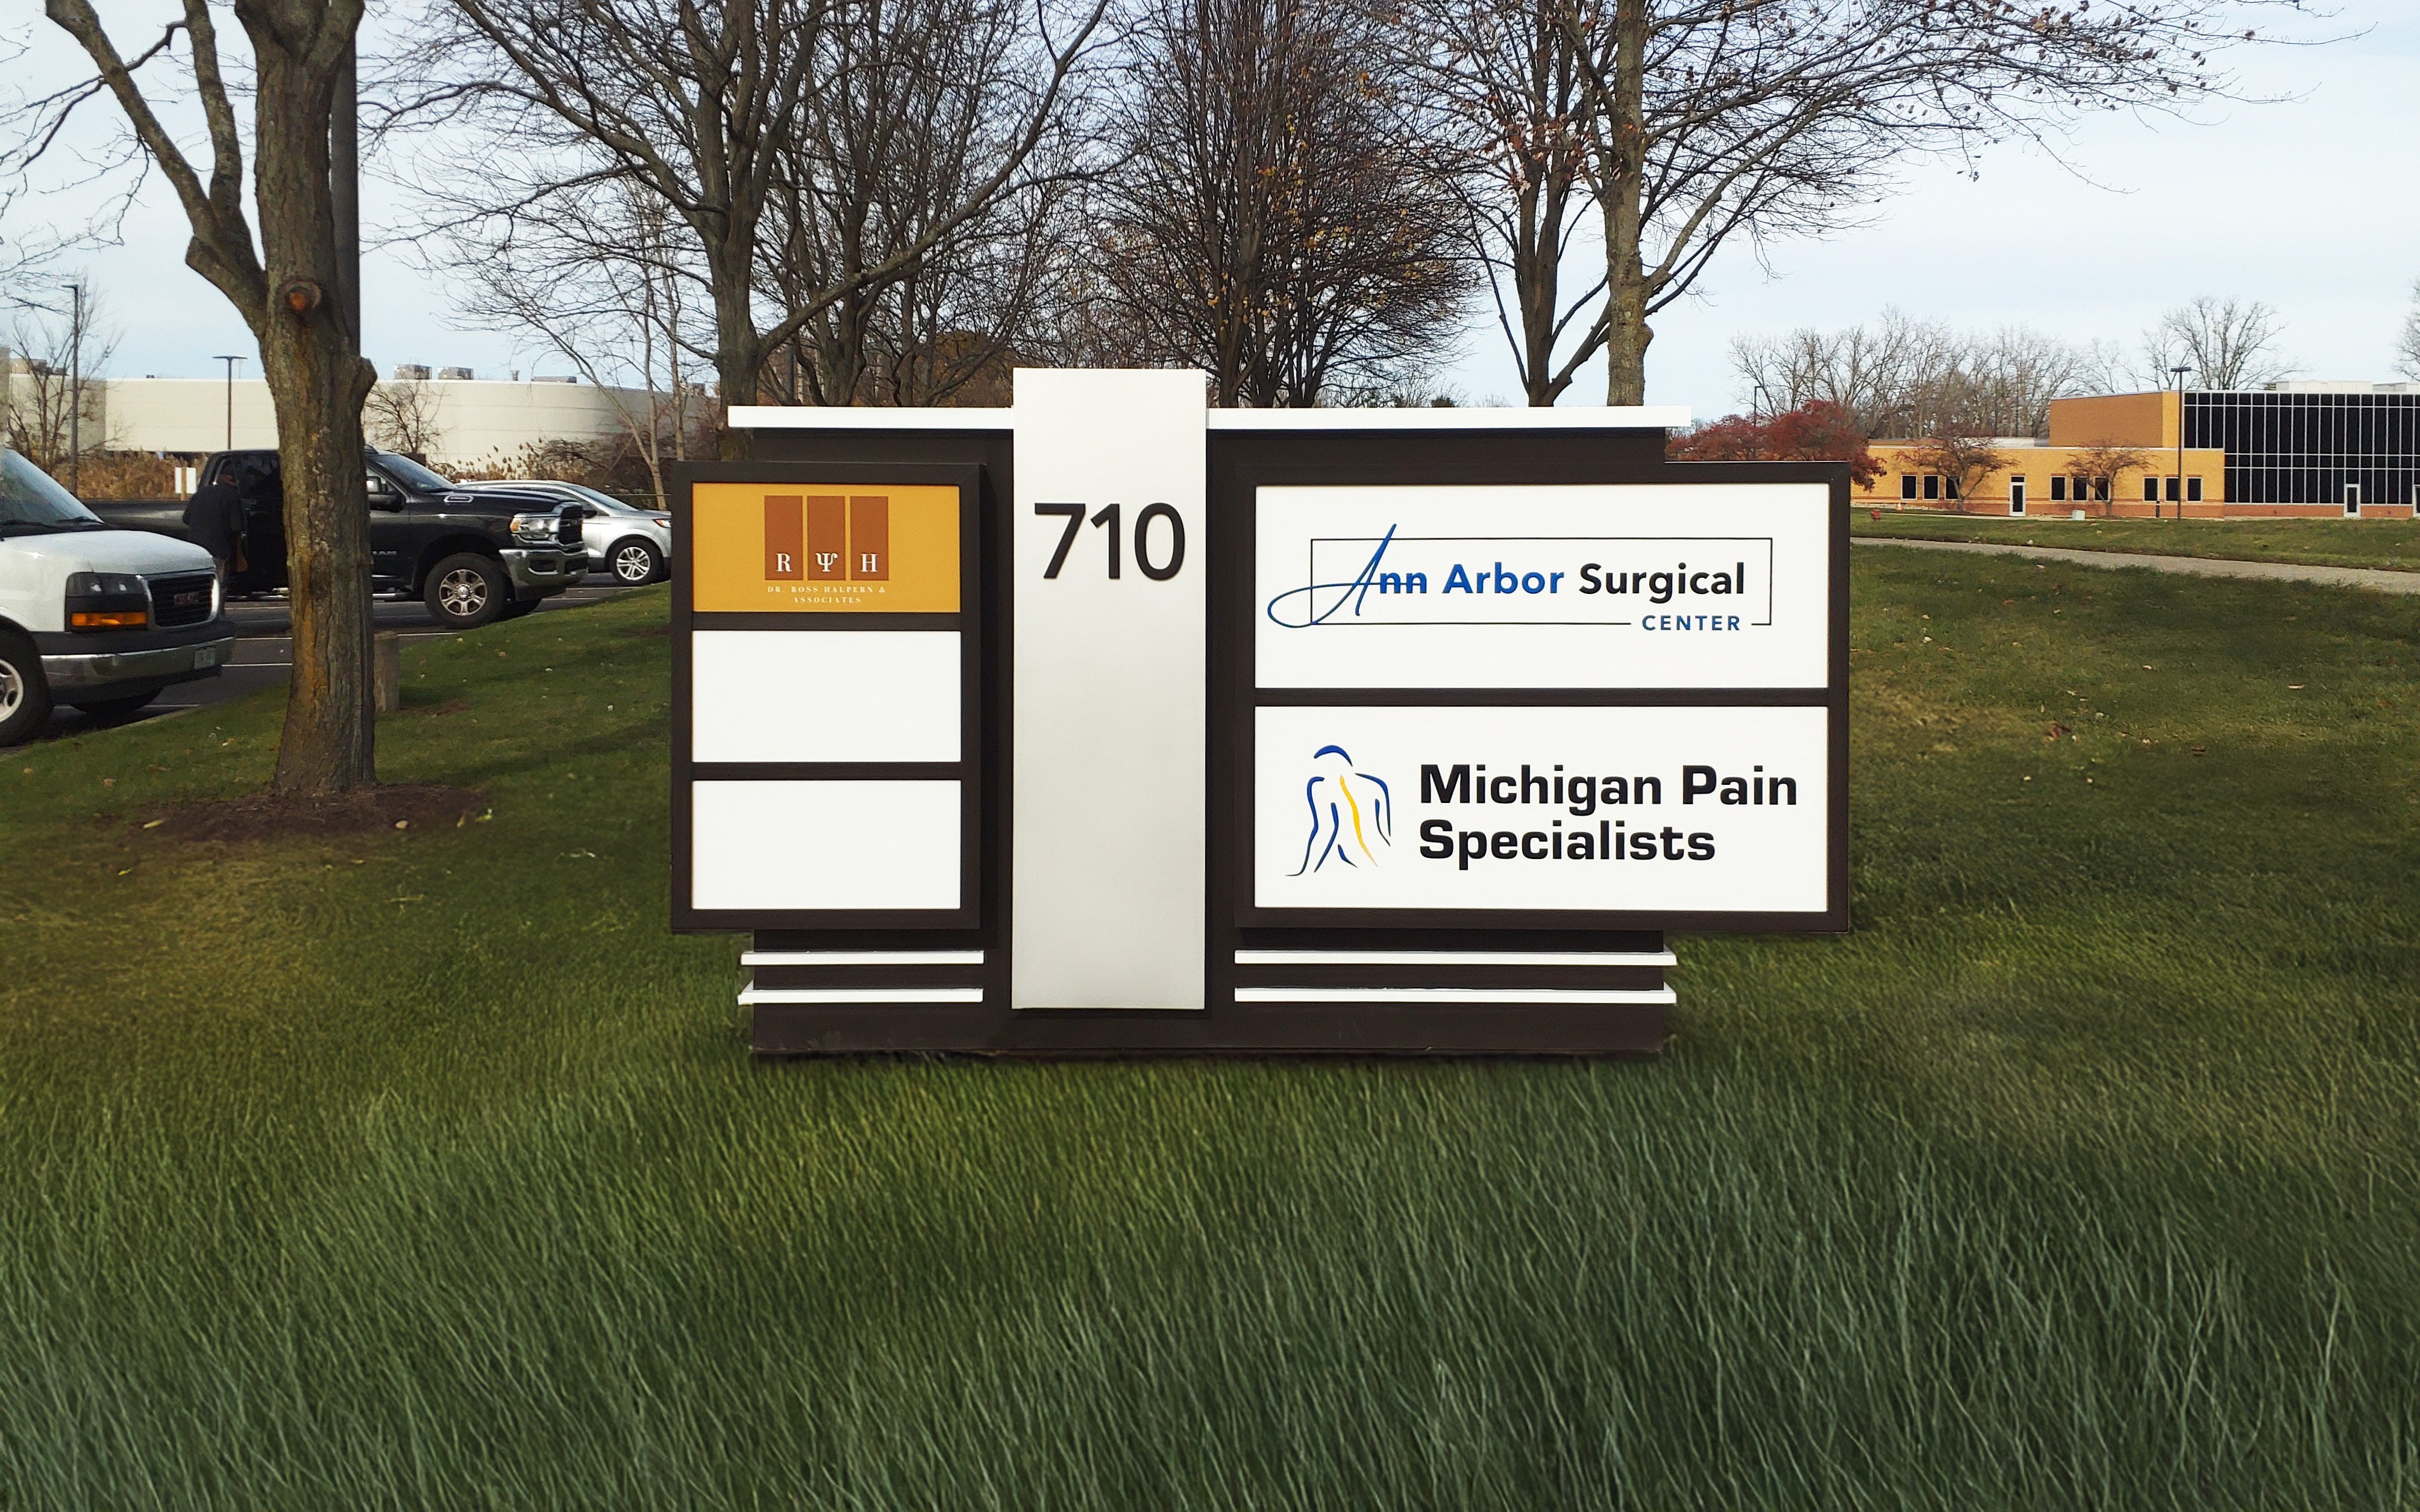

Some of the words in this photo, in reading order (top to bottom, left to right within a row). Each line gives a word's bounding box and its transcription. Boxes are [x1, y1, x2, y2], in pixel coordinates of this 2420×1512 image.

[776, 553, 792, 572] R
[860, 554, 879, 572] H
[1034, 502, 1185, 582] 710
[1268, 523, 1428, 628] Ann
[1443, 561, 1565, 595] Arbor
[1579, 561, 1745, 604] Surgical
[1642, 615, 1740, 631] CENTER
[1420, 764, 1661, 816] Michigan
[1682, 764, 1798, 806] Pain
[1420, 820, 1716, 870] Specialists
